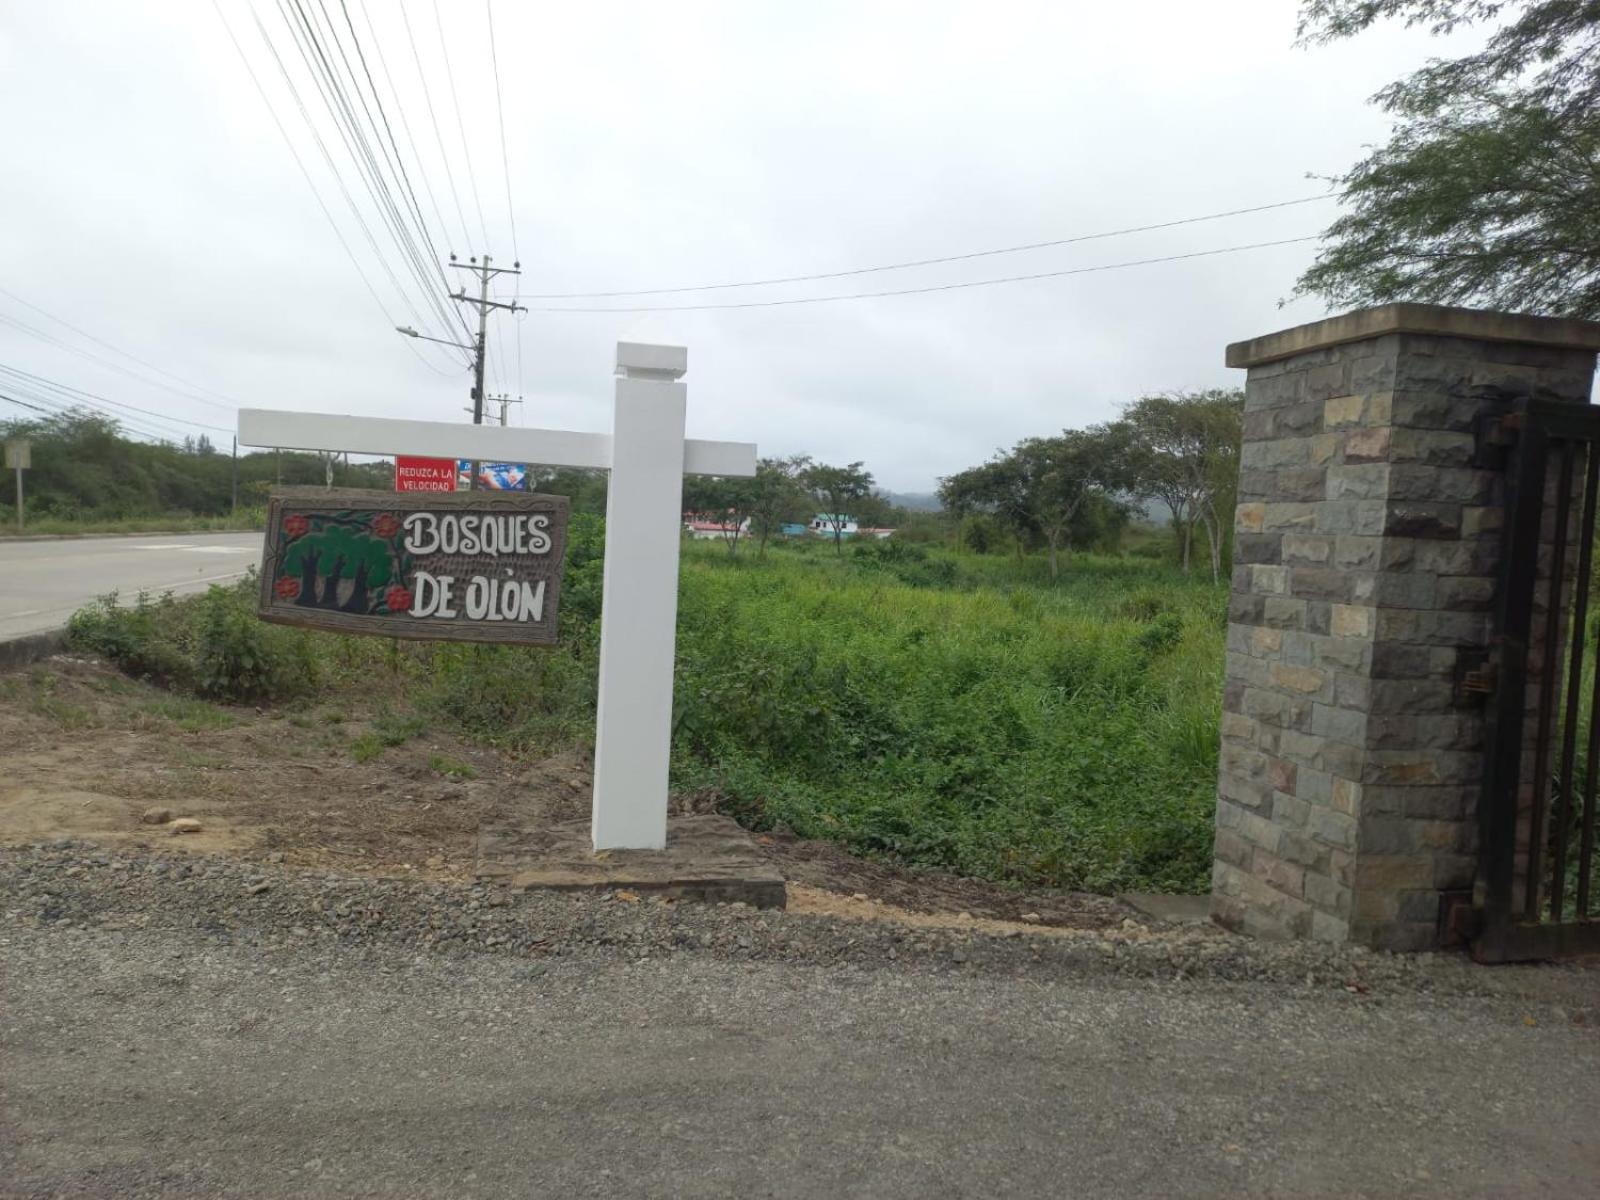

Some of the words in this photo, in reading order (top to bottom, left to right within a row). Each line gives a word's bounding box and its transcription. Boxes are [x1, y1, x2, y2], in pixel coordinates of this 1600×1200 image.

[400, 467, 438, 478] REDUZCA
[441, 469, 453, 479] LA
[403, 480, 449, 491] VELOCIDAD
[403, 513, 551, 556] BOSQUES
[408, 572, 457, 618] DE
